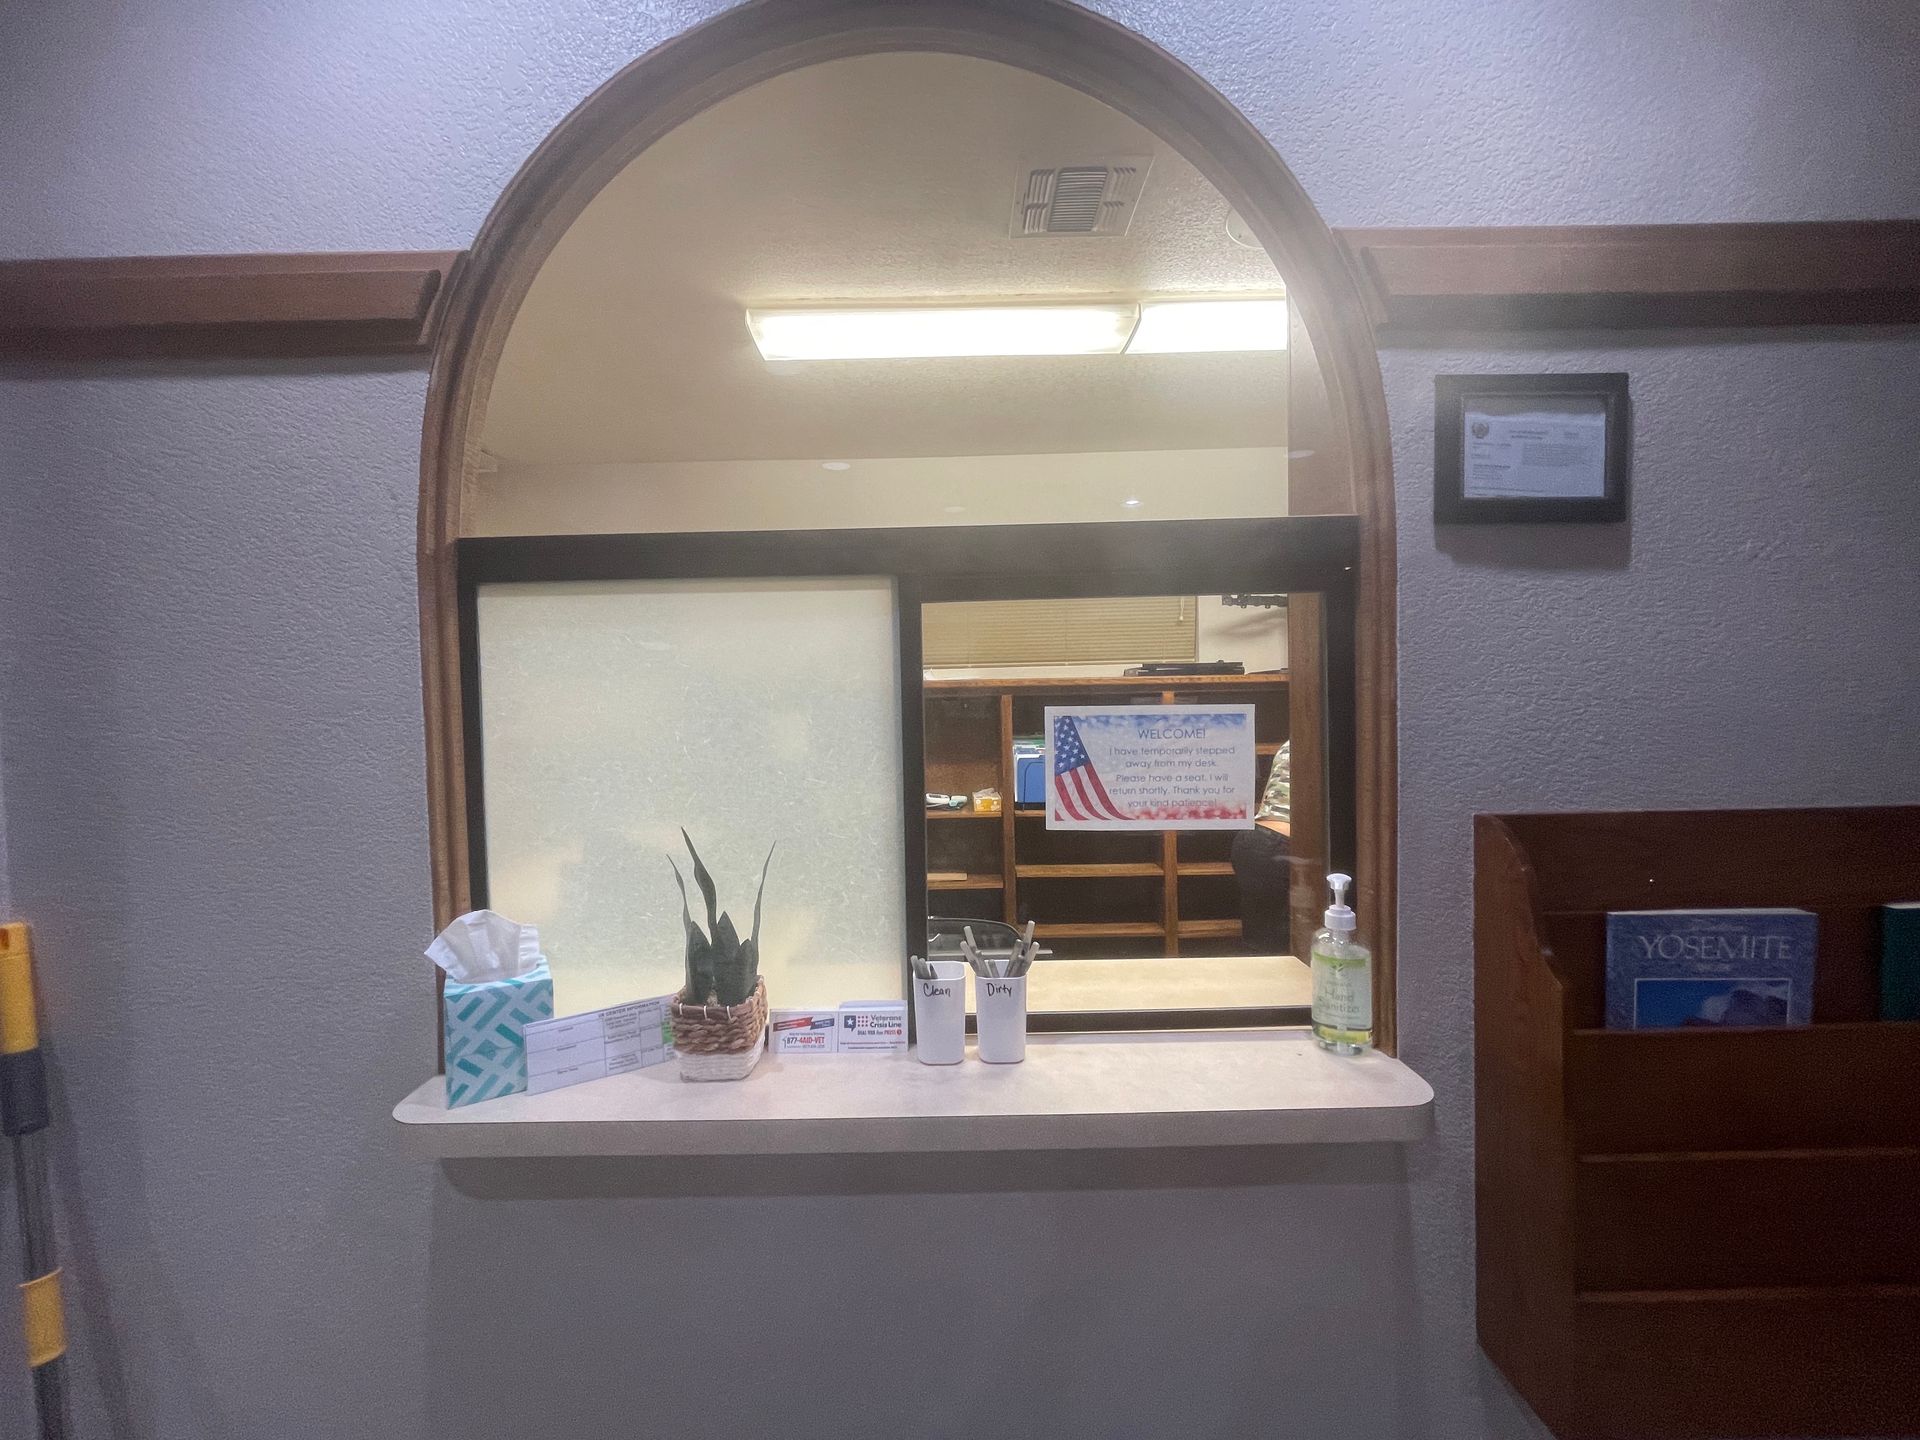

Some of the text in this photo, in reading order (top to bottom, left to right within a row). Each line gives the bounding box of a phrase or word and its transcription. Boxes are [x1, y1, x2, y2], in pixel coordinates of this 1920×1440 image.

[1138, 728, 1206, 740] WELCOME!
[1114, 747, 1140, 756] have
[1141, 746, 1193, 758] temporarily
[1195, 746, 1236, 758] stepped
[1125, 761, 1150, 769] away
[1153, 759, 1176, 768] from
[1177, 761, 1193, 769] my
[1116, 774, 1146, 783] Please
[1149, 774, 1174, 783] have
[1214, 774, 1229, 782] will
[1109, 787, 1137, 796] return
[1172, 786, 1199, 795] Thank
[1202, 787, 1220, 796] you
[1223, 785, 1236, 794] for
[1127, 800, 1148, 809] your
[1149, 799, 1171, 808] kind
[1637, 934, 1793, 960] YOSEMITE
[923, 982, 951, 998] Clean
[986, 982, 1012, 998] Dirty
[888, 1021, 902, 1029] Line
